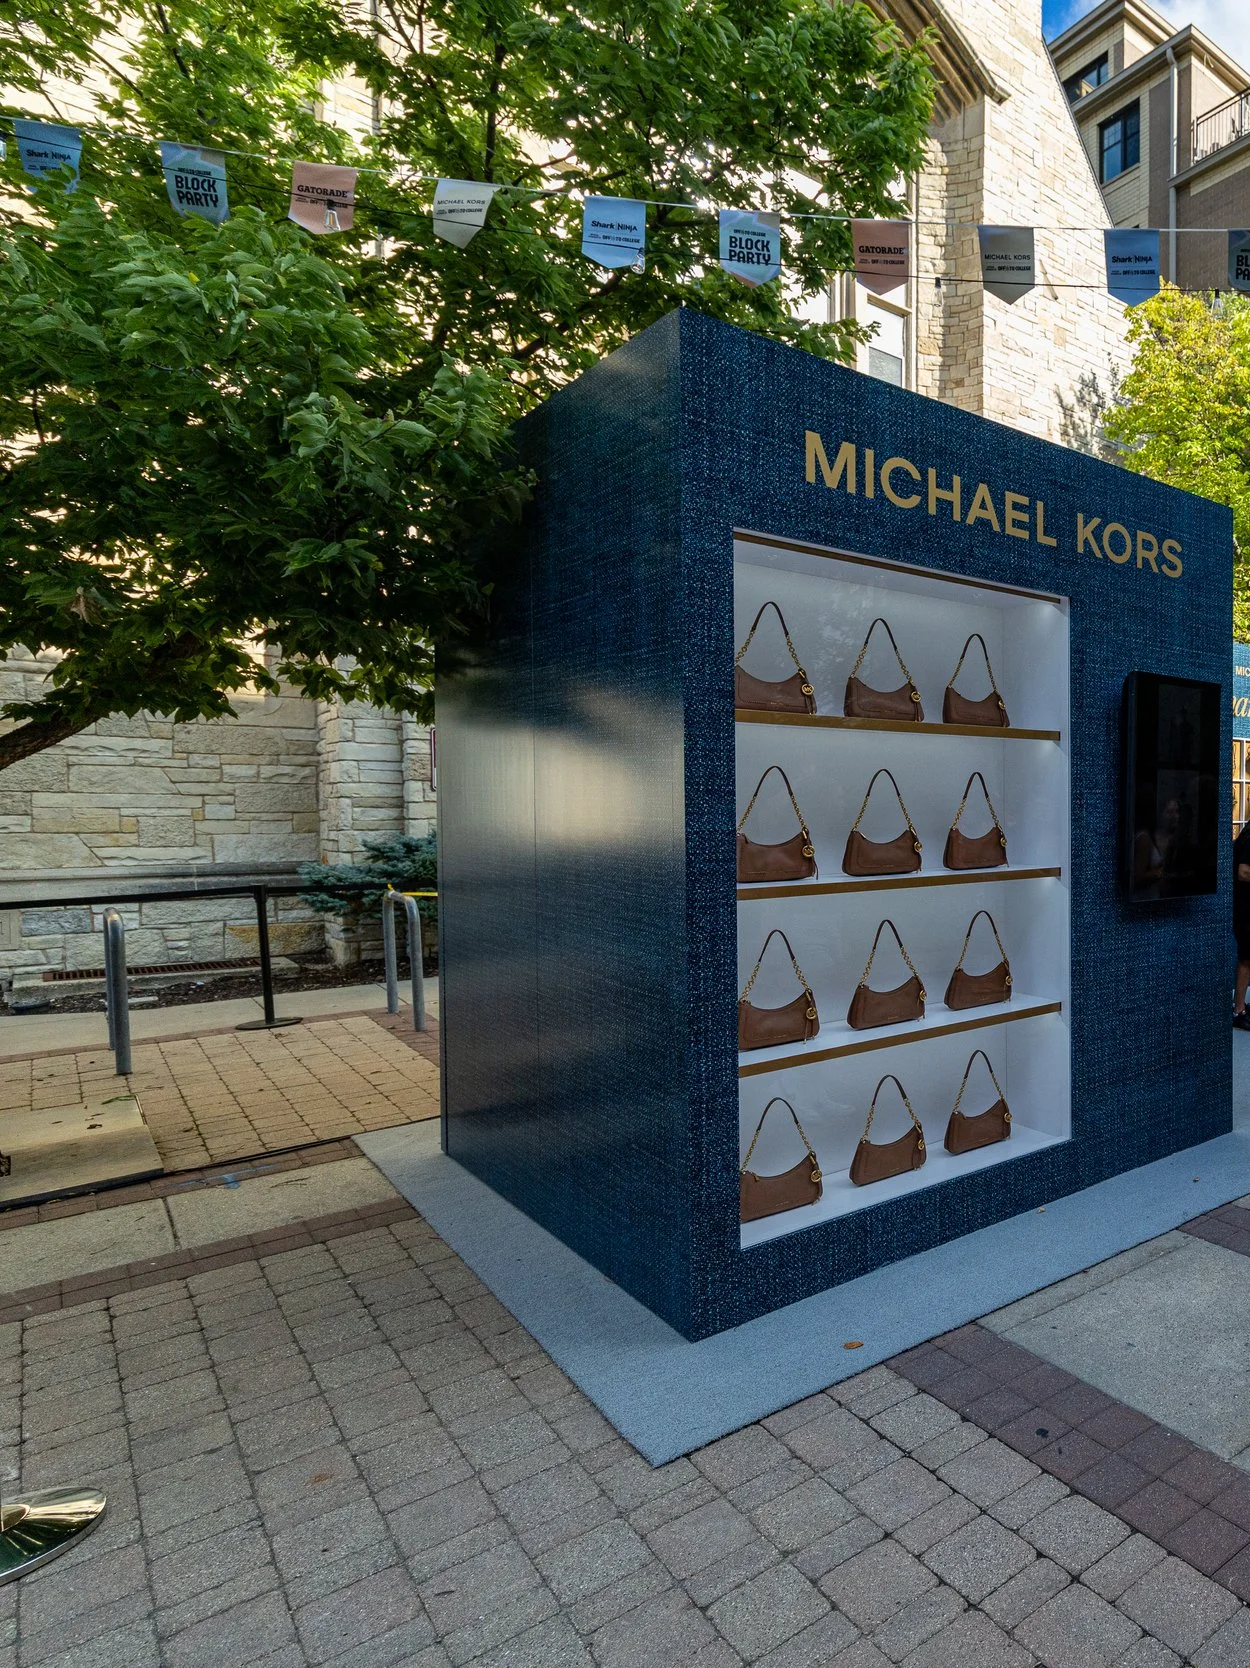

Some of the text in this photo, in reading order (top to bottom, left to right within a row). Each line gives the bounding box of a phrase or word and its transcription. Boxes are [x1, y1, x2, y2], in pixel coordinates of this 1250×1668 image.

[26, 149, 49, 159] Shark
[174, 175, 217, 193] BLOCK
[176, 190, 219, 208] PARTY
[296, 185, 348, 199] GATORADE
[591, 220, 615, 230] Shark
[622, 236, 640, 244] COLLEGE
[729, 235, 771, 253] BLOCK
[728, 249, 771, 266] PARTY
[858, 245, 905, 255] GATORADE
[804, 430, 1184, 579] MICHAEL KORS
